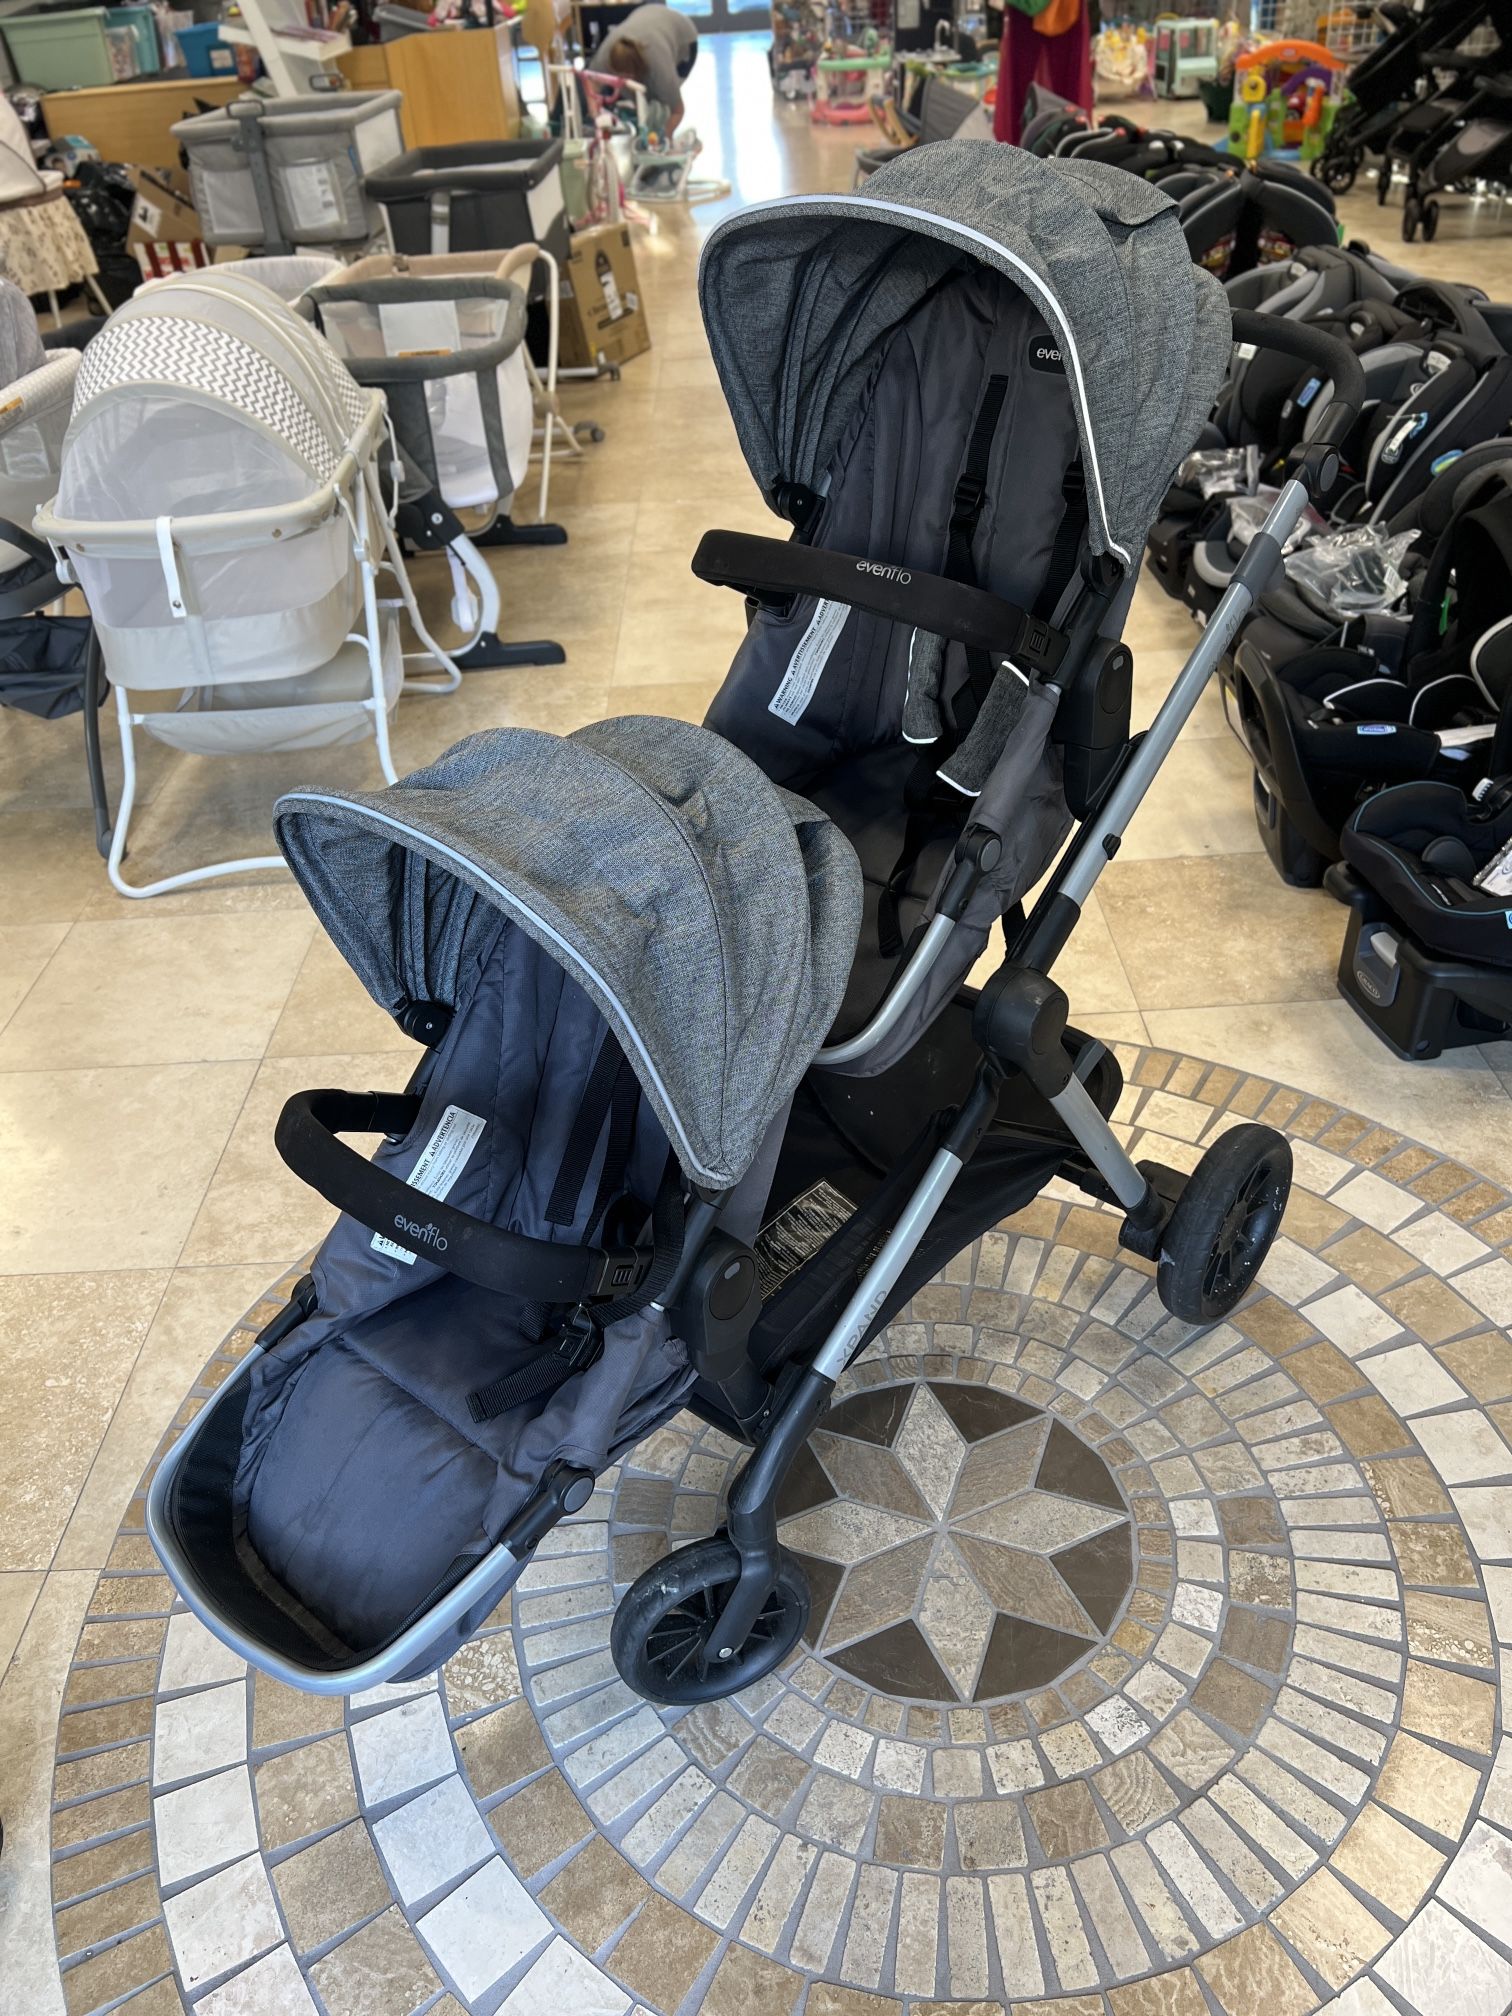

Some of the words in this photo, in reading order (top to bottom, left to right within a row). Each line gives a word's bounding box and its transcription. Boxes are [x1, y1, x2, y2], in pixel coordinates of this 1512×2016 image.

[856, 560, 911, 584] evenflo
[776, 677, 793, 705] WARNING
[792, 626, 816, 672] AVERTISSEMENT
[433, 1112, 457, 1151] ADVERTENCIA
[394, 1214, 448, 1251] evenflo
[837, 1290, 887, 1366] XPAND
